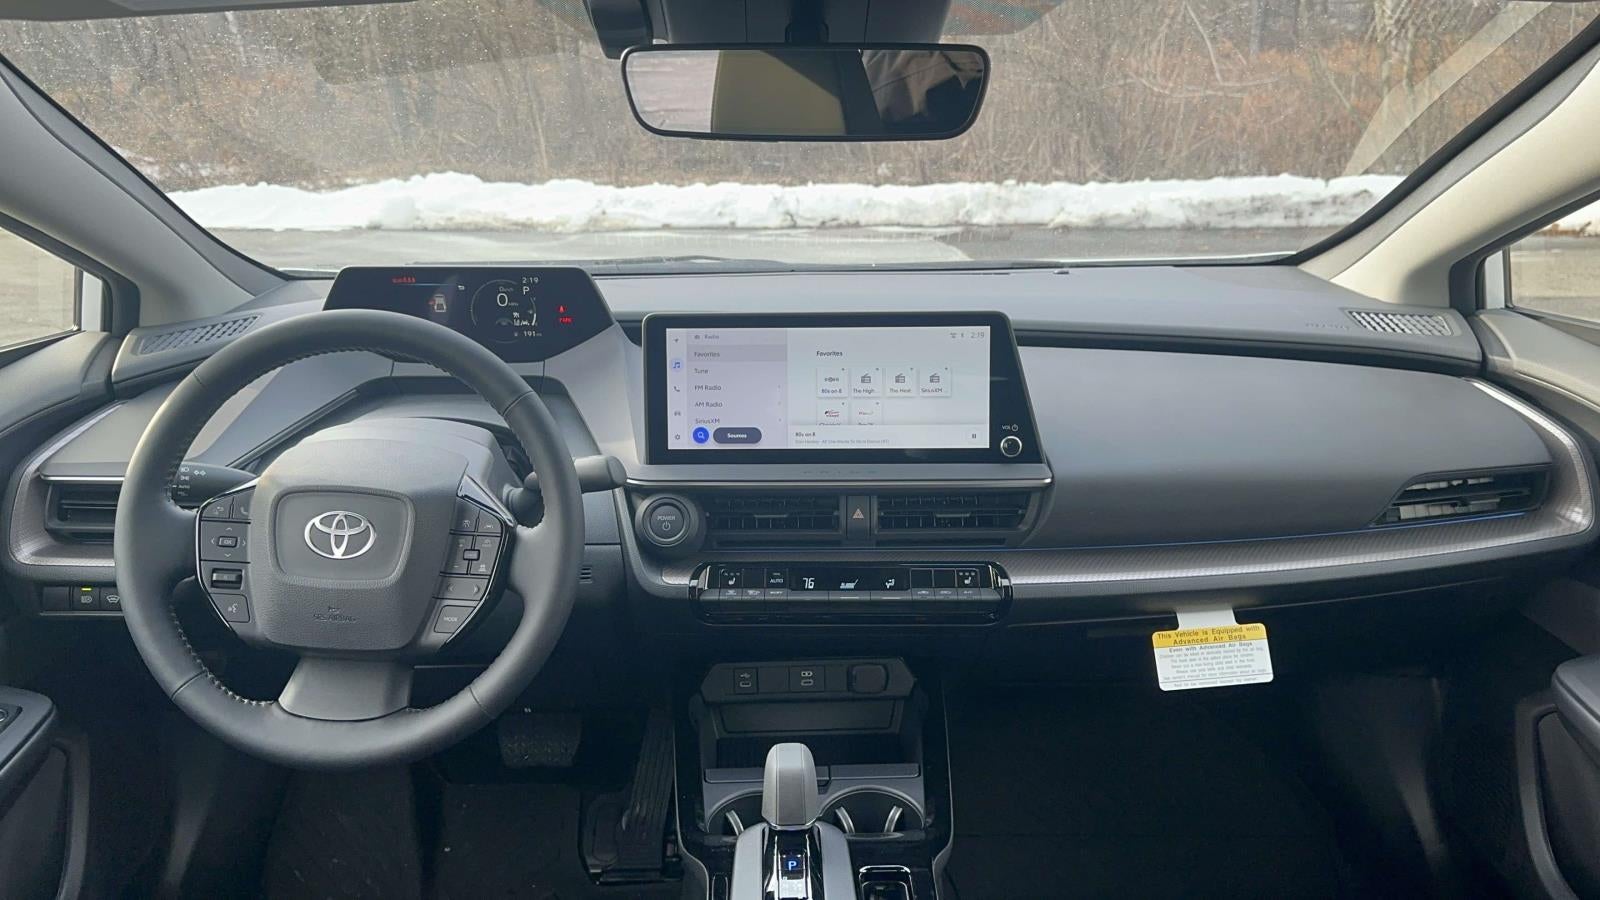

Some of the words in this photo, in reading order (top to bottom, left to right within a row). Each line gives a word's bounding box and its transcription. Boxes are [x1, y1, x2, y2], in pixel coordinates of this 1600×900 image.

[522, 286, 530, 295] P
[496, 292, 508, 307] 0
[970, 331, 985, 339] 2:19
[802, 577, 815, 589] 76
[1211, 627, 1243, 636] Equipped
[1173, 638, 1209, 646] Advanced
[1228, 634, 1247, 642] Bags
[788, 860, 797, 871] P
